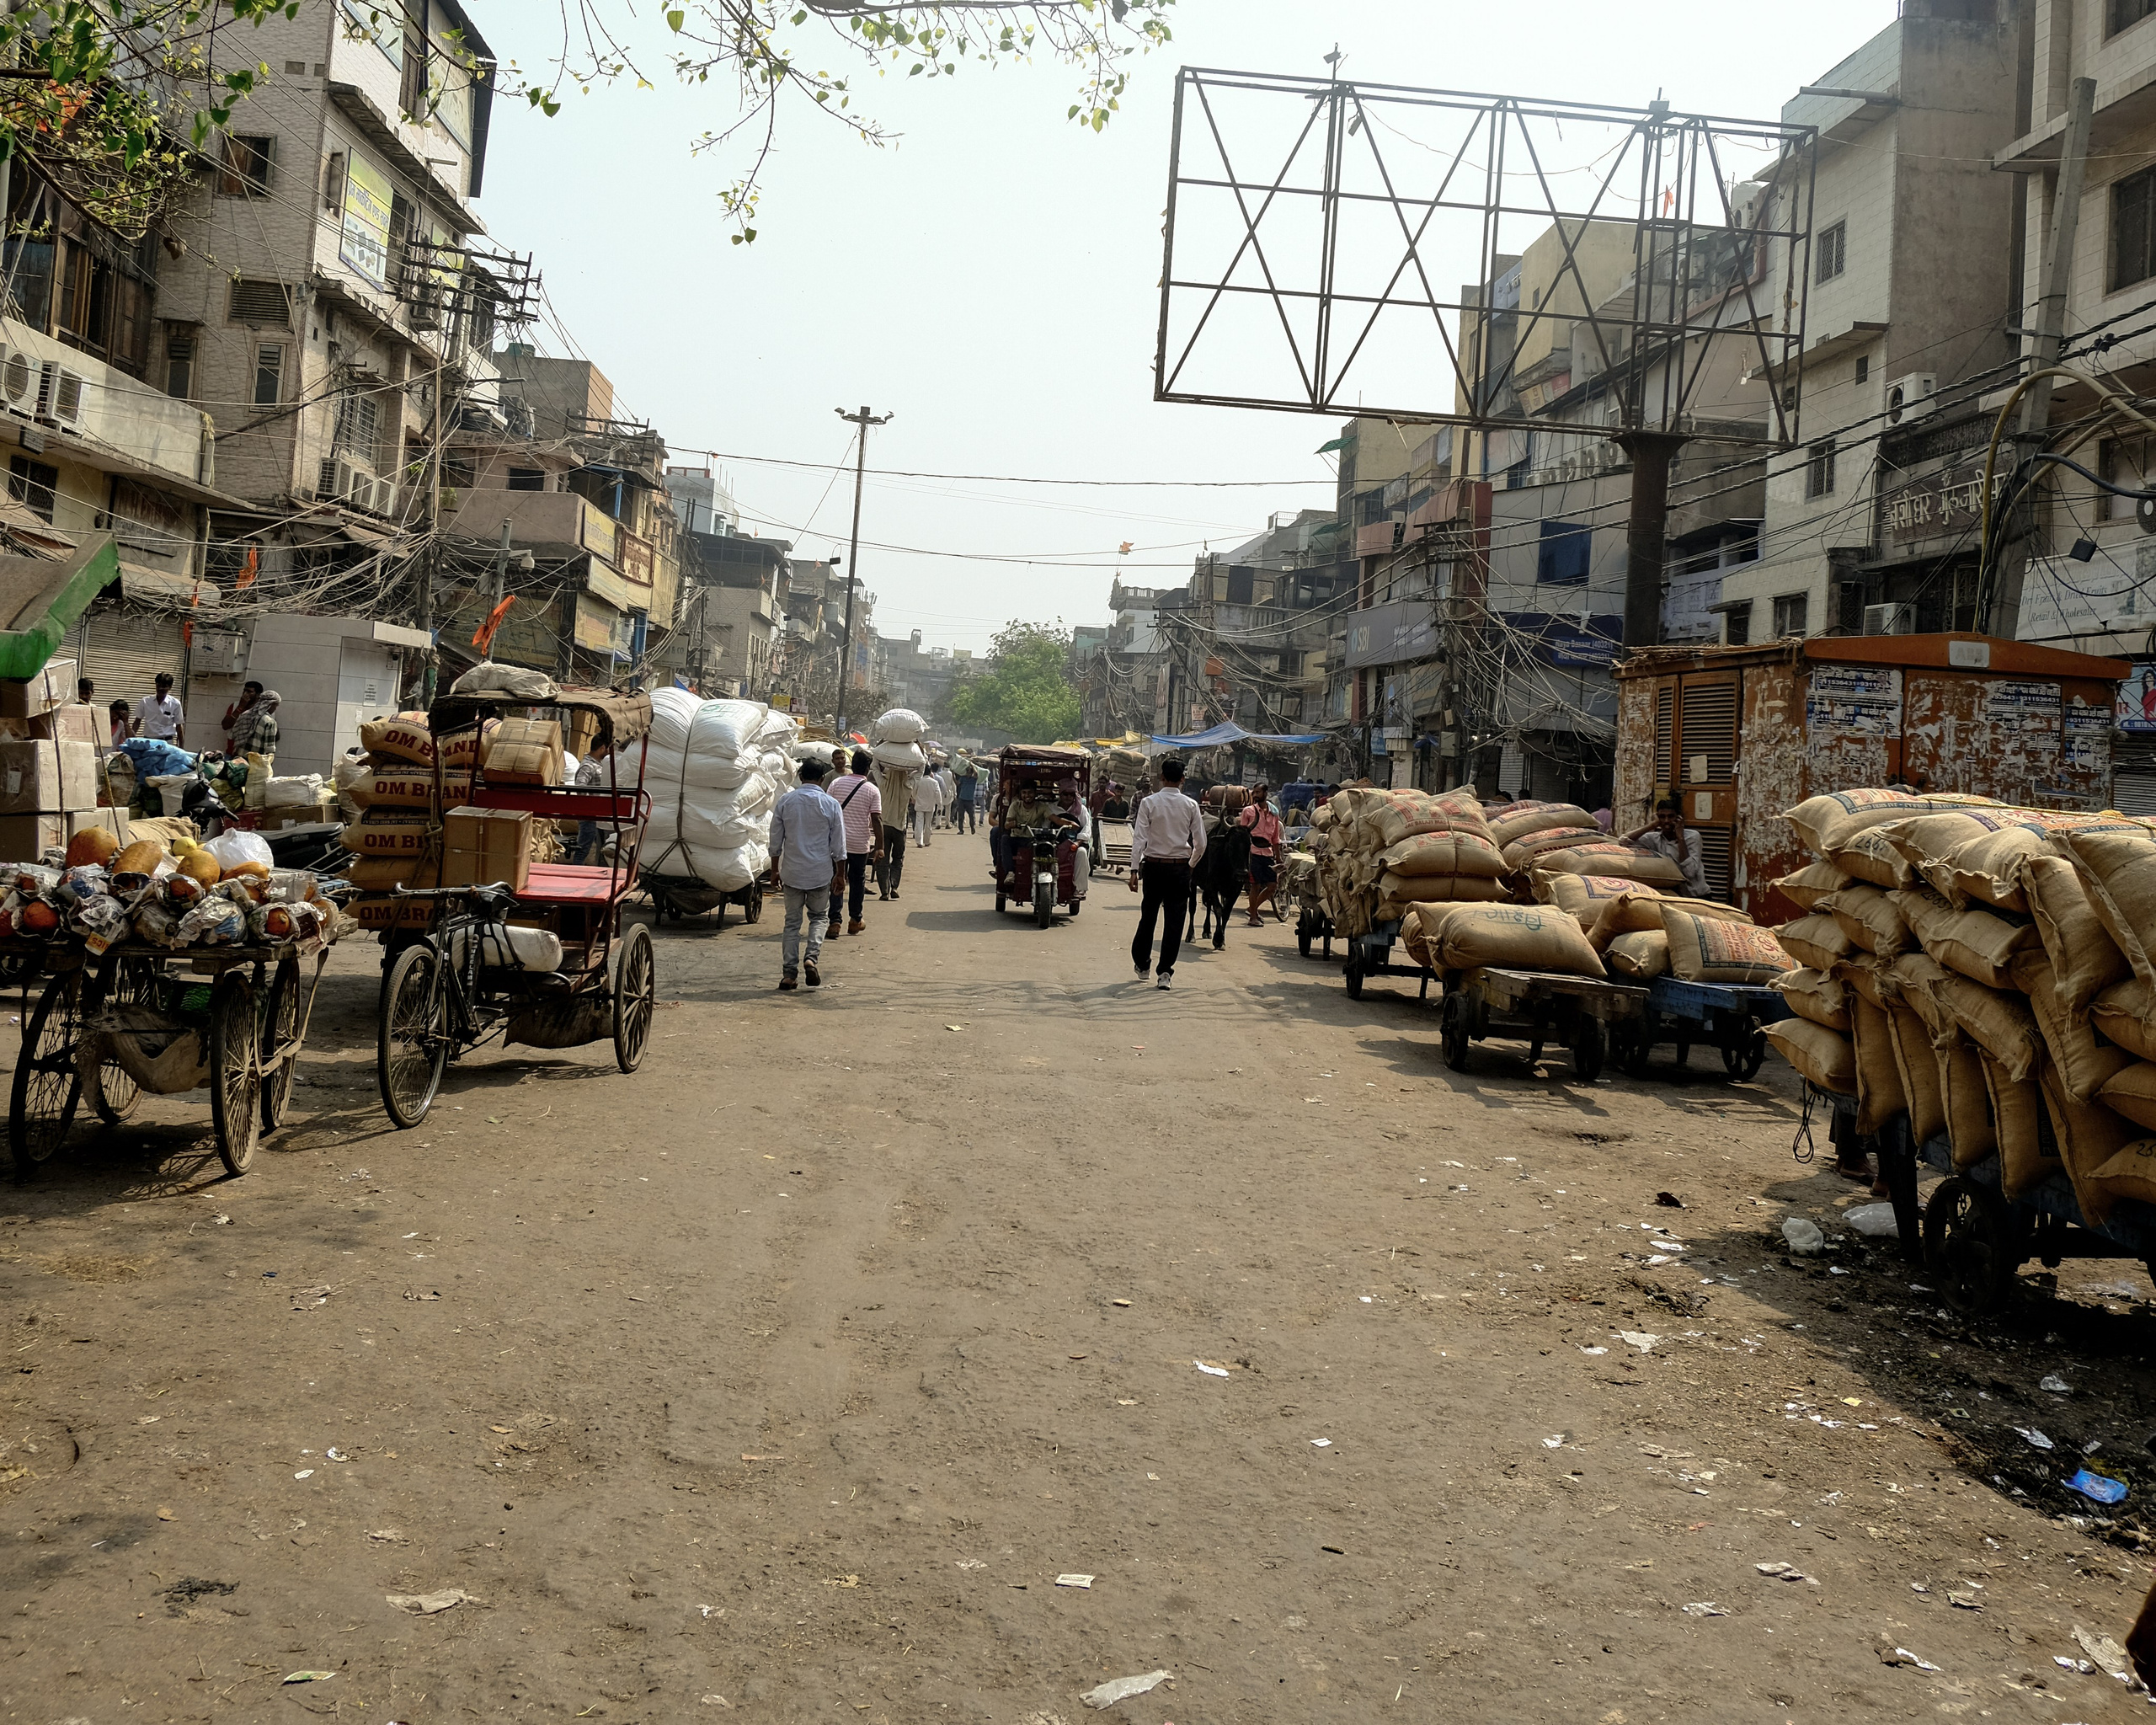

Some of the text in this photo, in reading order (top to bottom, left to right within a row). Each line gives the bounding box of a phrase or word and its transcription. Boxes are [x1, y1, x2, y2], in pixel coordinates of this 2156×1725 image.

[2031, 610, 2050, 622] Retail
[1357, 626, 1370, 653] SBI
[384, 730, 418, 749] OM
[375, 781, 406, 795] OM
[364, 834, 397, 848] OM
[360, 906, 392, 921] OM
